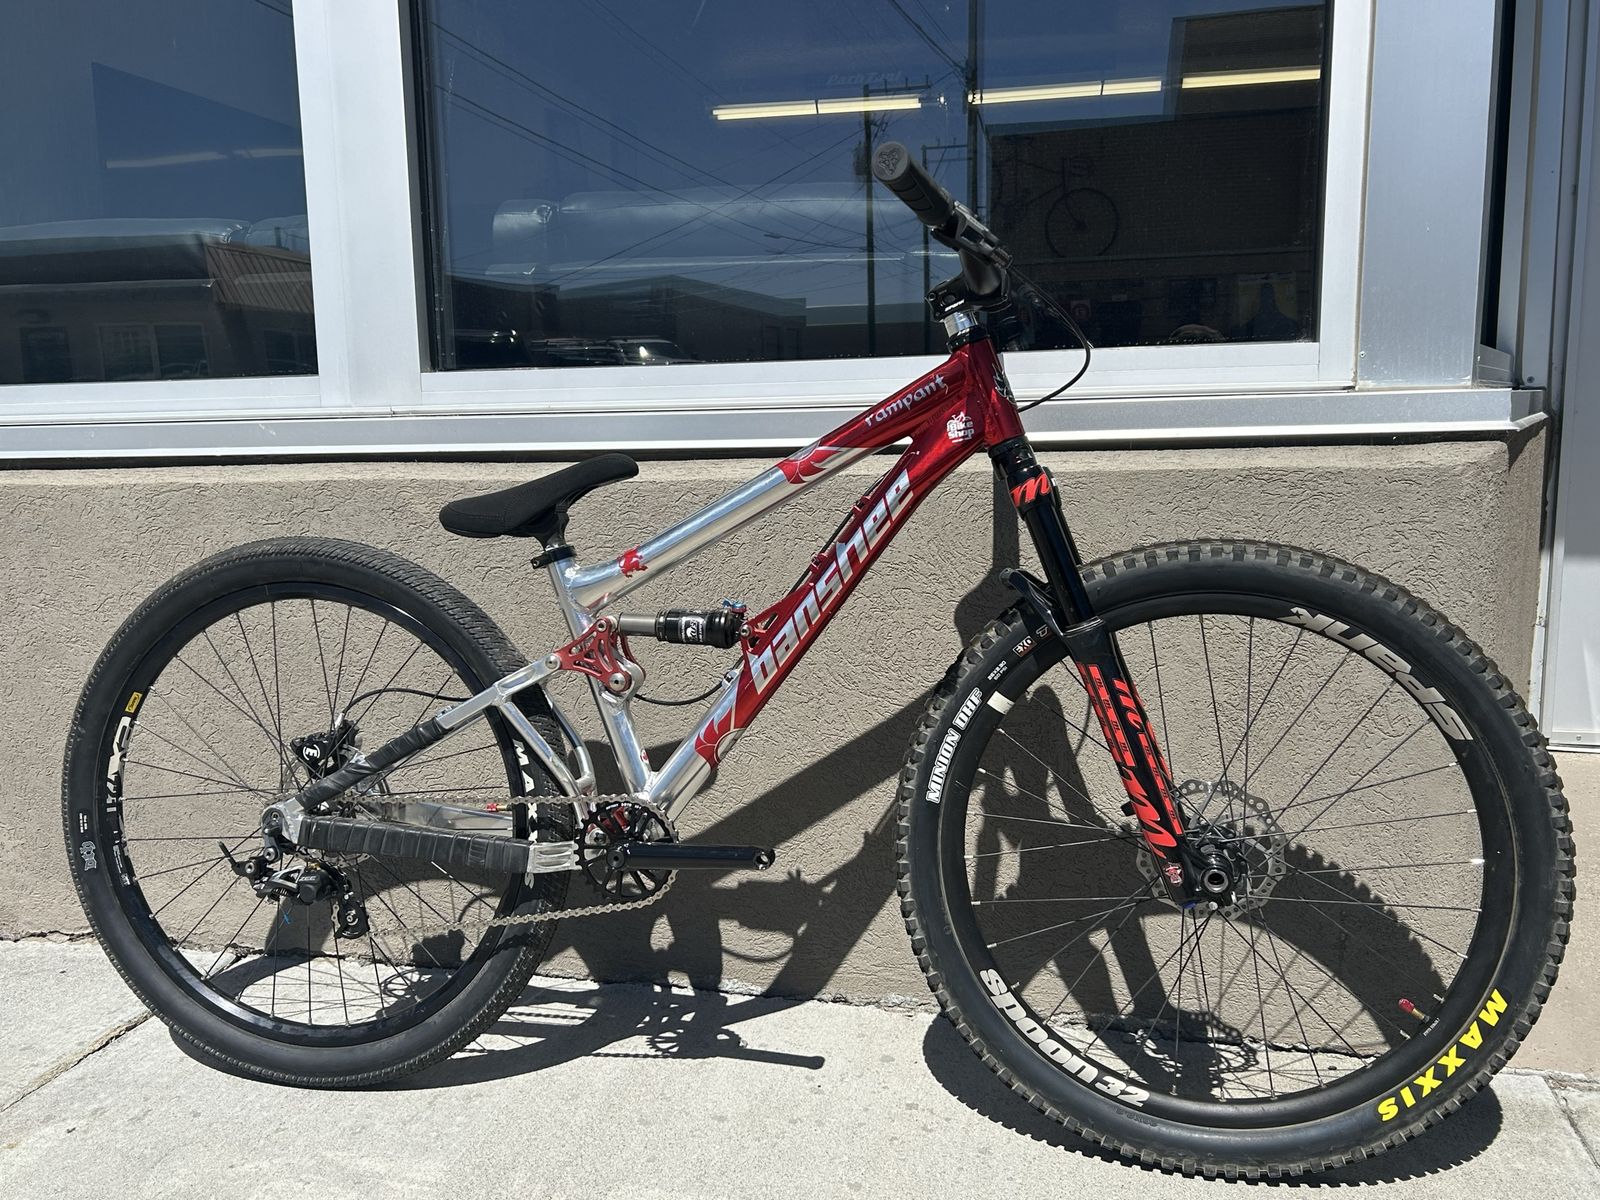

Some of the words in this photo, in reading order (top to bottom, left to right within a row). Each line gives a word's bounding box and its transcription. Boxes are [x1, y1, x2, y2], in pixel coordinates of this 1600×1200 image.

[864, 374, 949, 427] rampant
[748, 468, 914, 695] banshee
[926, 727, 962, 804] MINION
[951, 687, 983, 731] DHF
[512, 738, 539, 889] MAXXS
[1377, 988, 1508, 1122] MAXXIS
